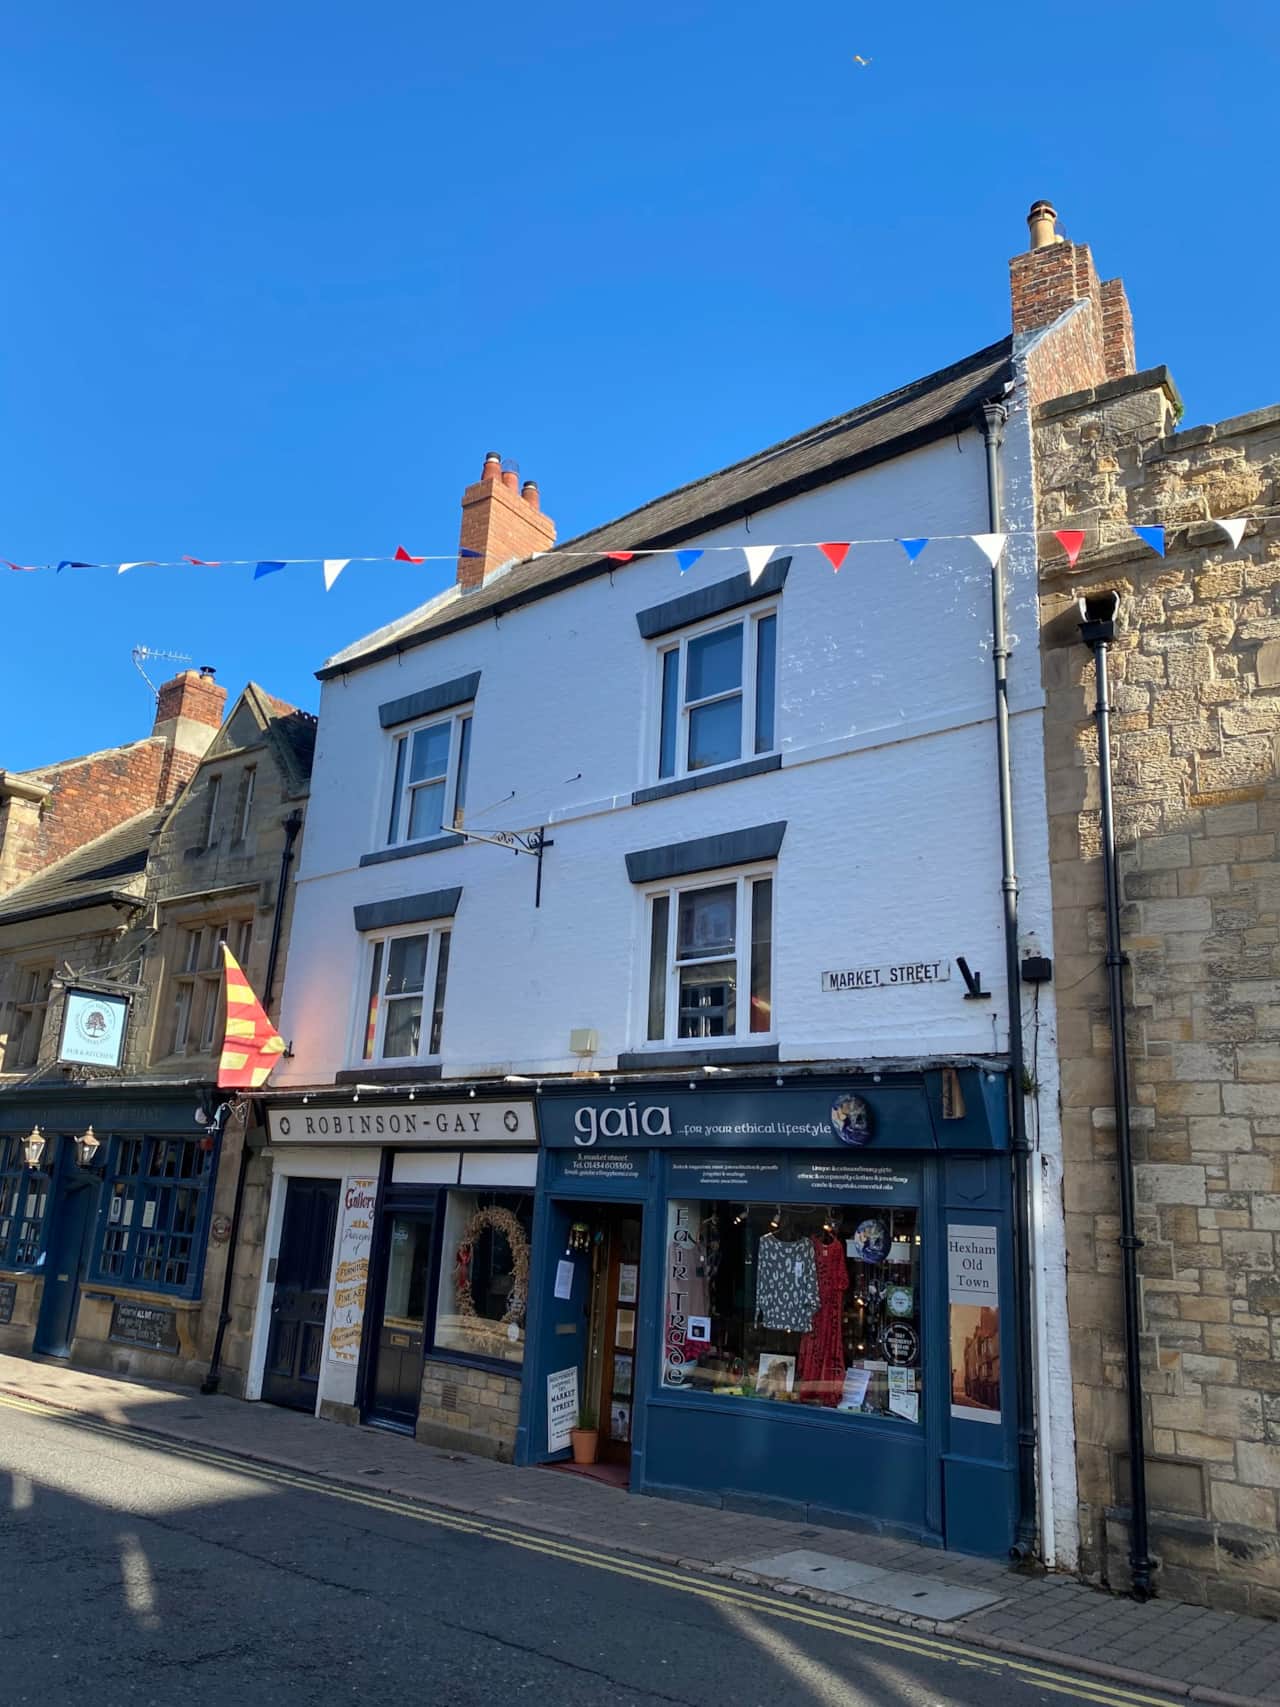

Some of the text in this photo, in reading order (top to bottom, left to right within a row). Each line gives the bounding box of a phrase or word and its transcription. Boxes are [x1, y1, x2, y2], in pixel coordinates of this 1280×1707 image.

[830, 963, 940, 988] MARKET STREET
[305, 1112, 481, 1135] ROBINSON-GAY
[704, 1124, 732, 1136] your
[734, 1122, 775, 1134] ethical
[777, 1122, 832, 1136] lifestyle
[949, 1241, 996, 1255] Hexham
[962, 1258, 983, 1271] Old
[956, 1274, 989, 1288] Town
[551, 1388, 575, 1402] MARKET
[552, 1400, 575, 1413] STREET
